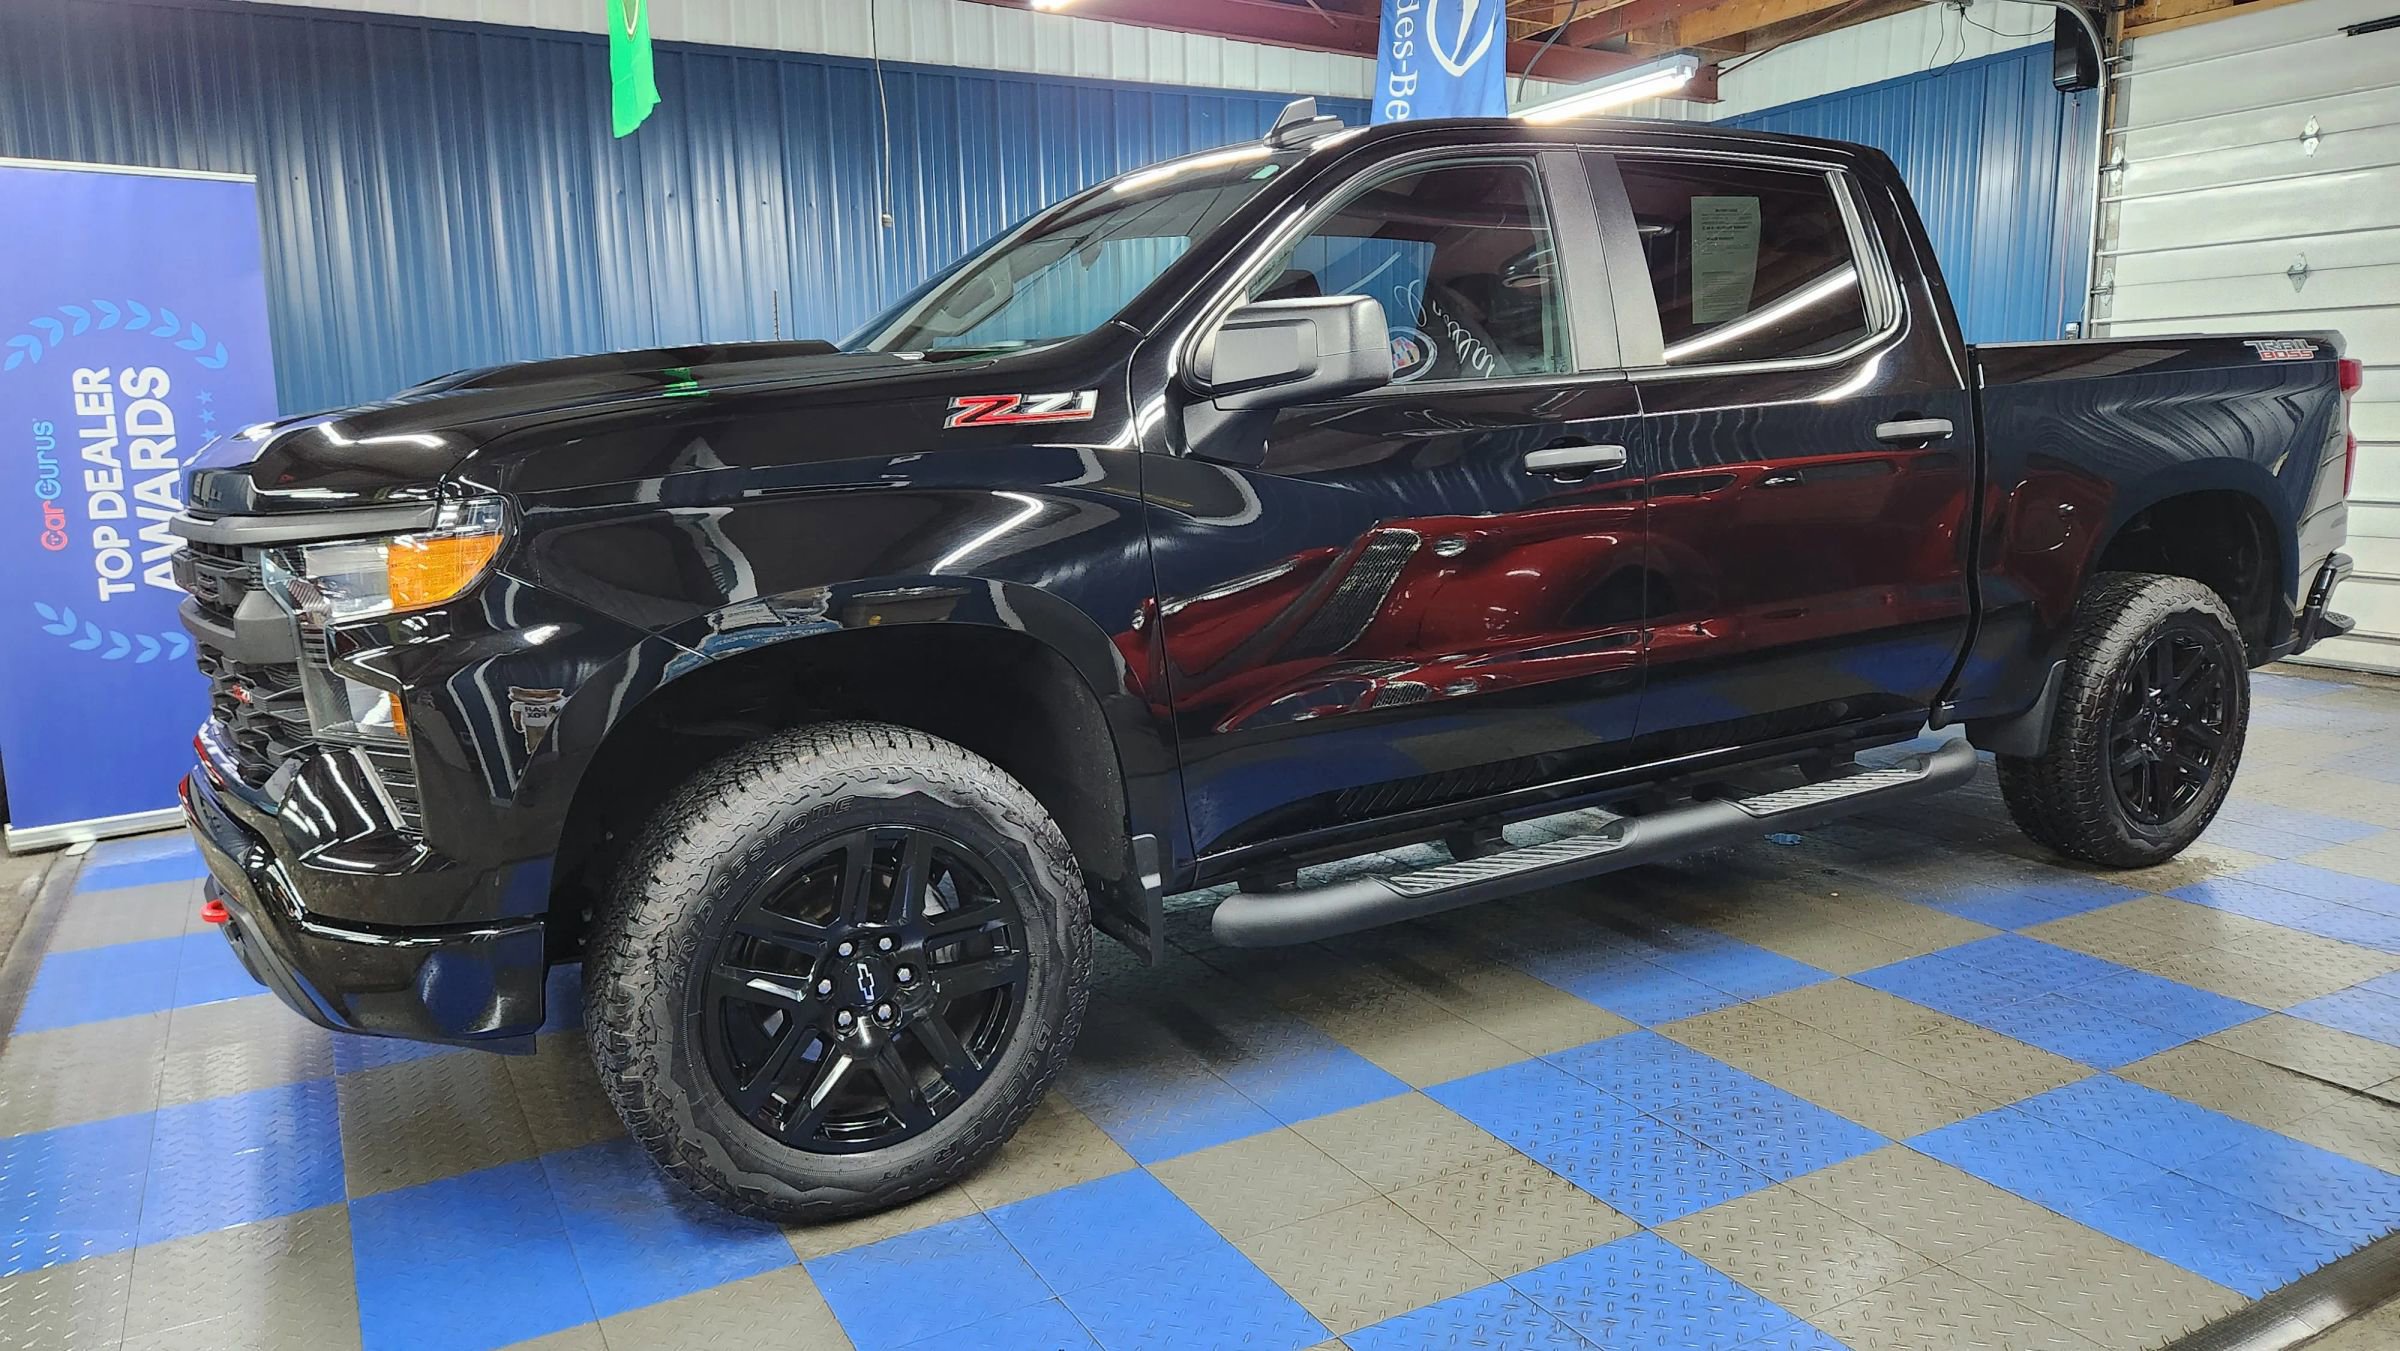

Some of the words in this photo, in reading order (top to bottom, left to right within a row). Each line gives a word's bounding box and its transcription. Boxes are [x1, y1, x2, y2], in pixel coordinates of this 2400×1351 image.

[2243, 339, 2319, 351] TRAIL
[2260, 350, 2314, 360] BOSS
[72, 366, 128, 520] DEALER
[943, 389, 1098, 429] Z71
[33, 420, 68, 551] CarGurus
[119, 366, 189, 595] AWARDS
[91, 525, 136, 601] TOP
